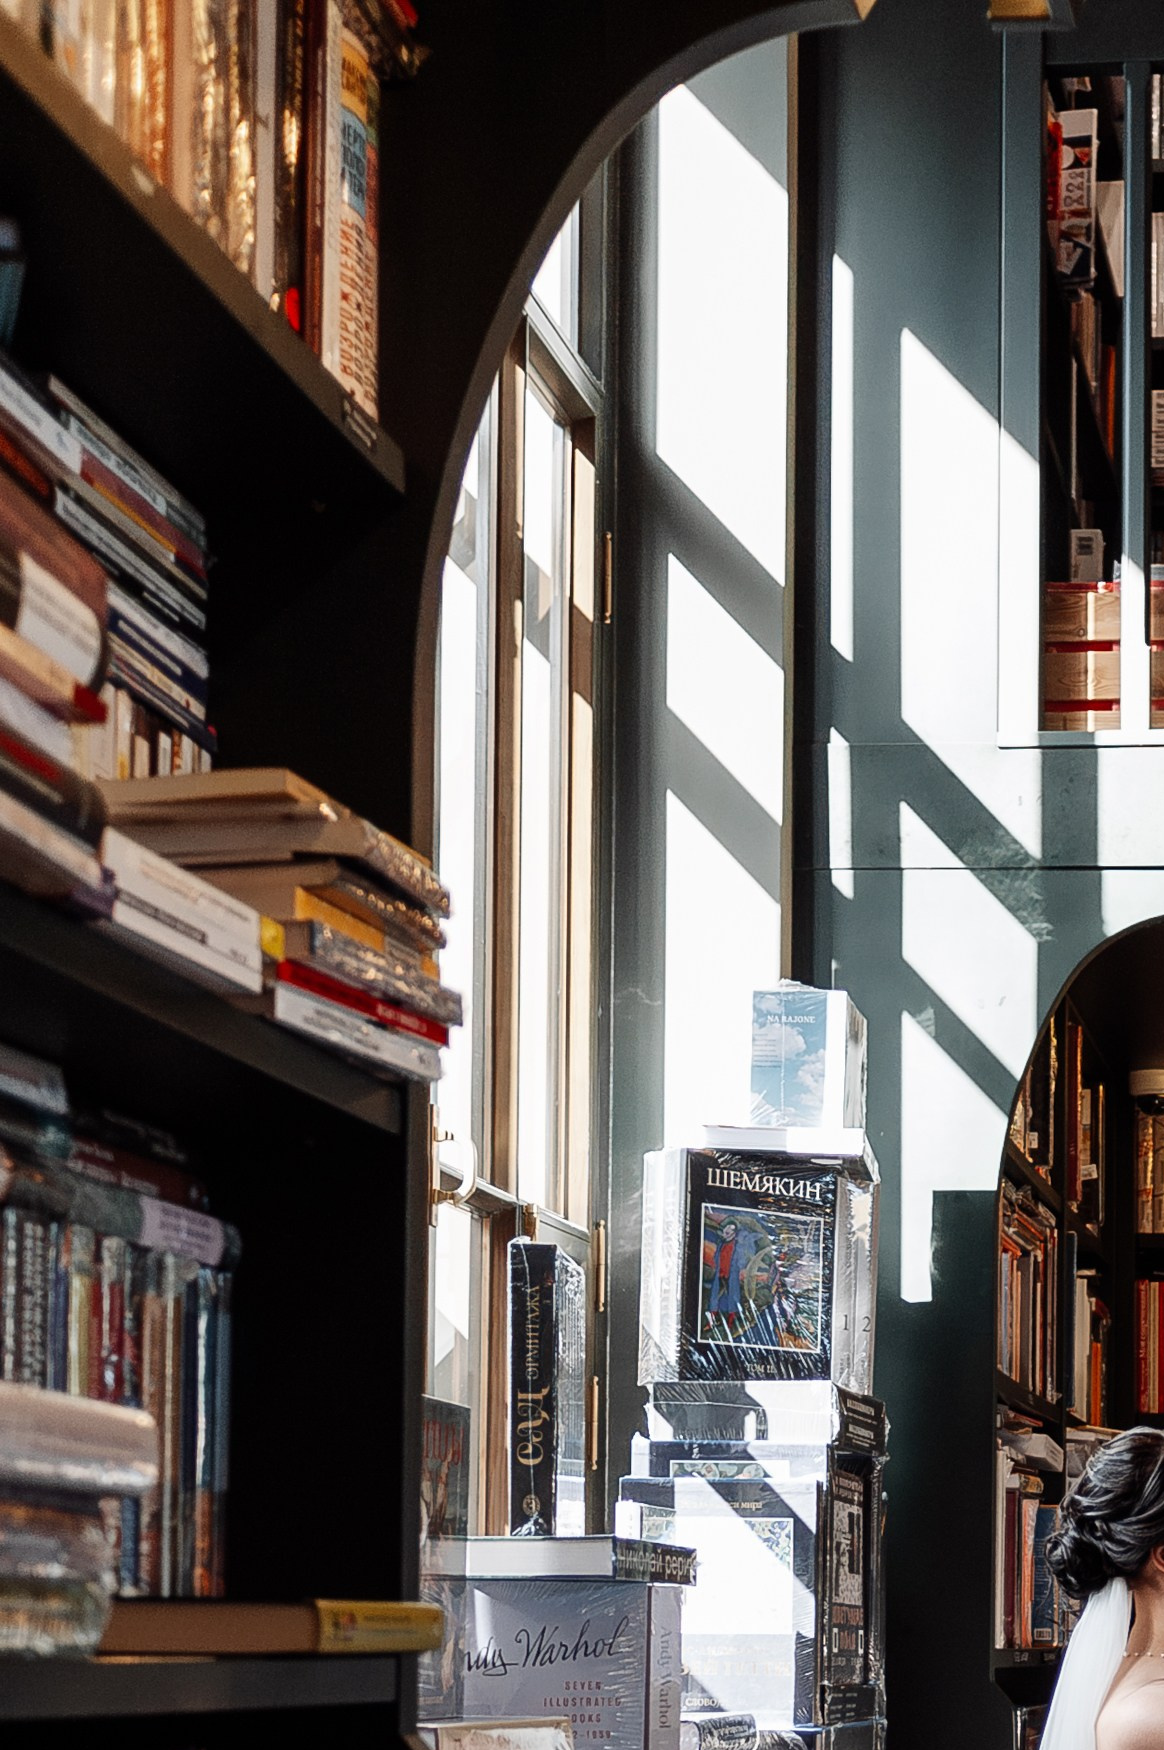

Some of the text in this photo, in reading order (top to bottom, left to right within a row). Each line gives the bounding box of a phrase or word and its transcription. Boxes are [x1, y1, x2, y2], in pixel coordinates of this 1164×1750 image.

[767, 1014, 780, 1025] NA
[706, 1167, 822, 1201] ШЕМЯКИН
[841, 1314, 851, 1333] 1
[861, 1315, 872, 1334] 2
[514, 1615, 630, 1668] Warhol
[564, 1680, 602, 1691] SEVEN
[658, 1626, 674, 1729] Andy Warhol
[543, 1697, 622, 1708] ILLUSTRATED
[564, 1713, 602, 1723] OOKS
